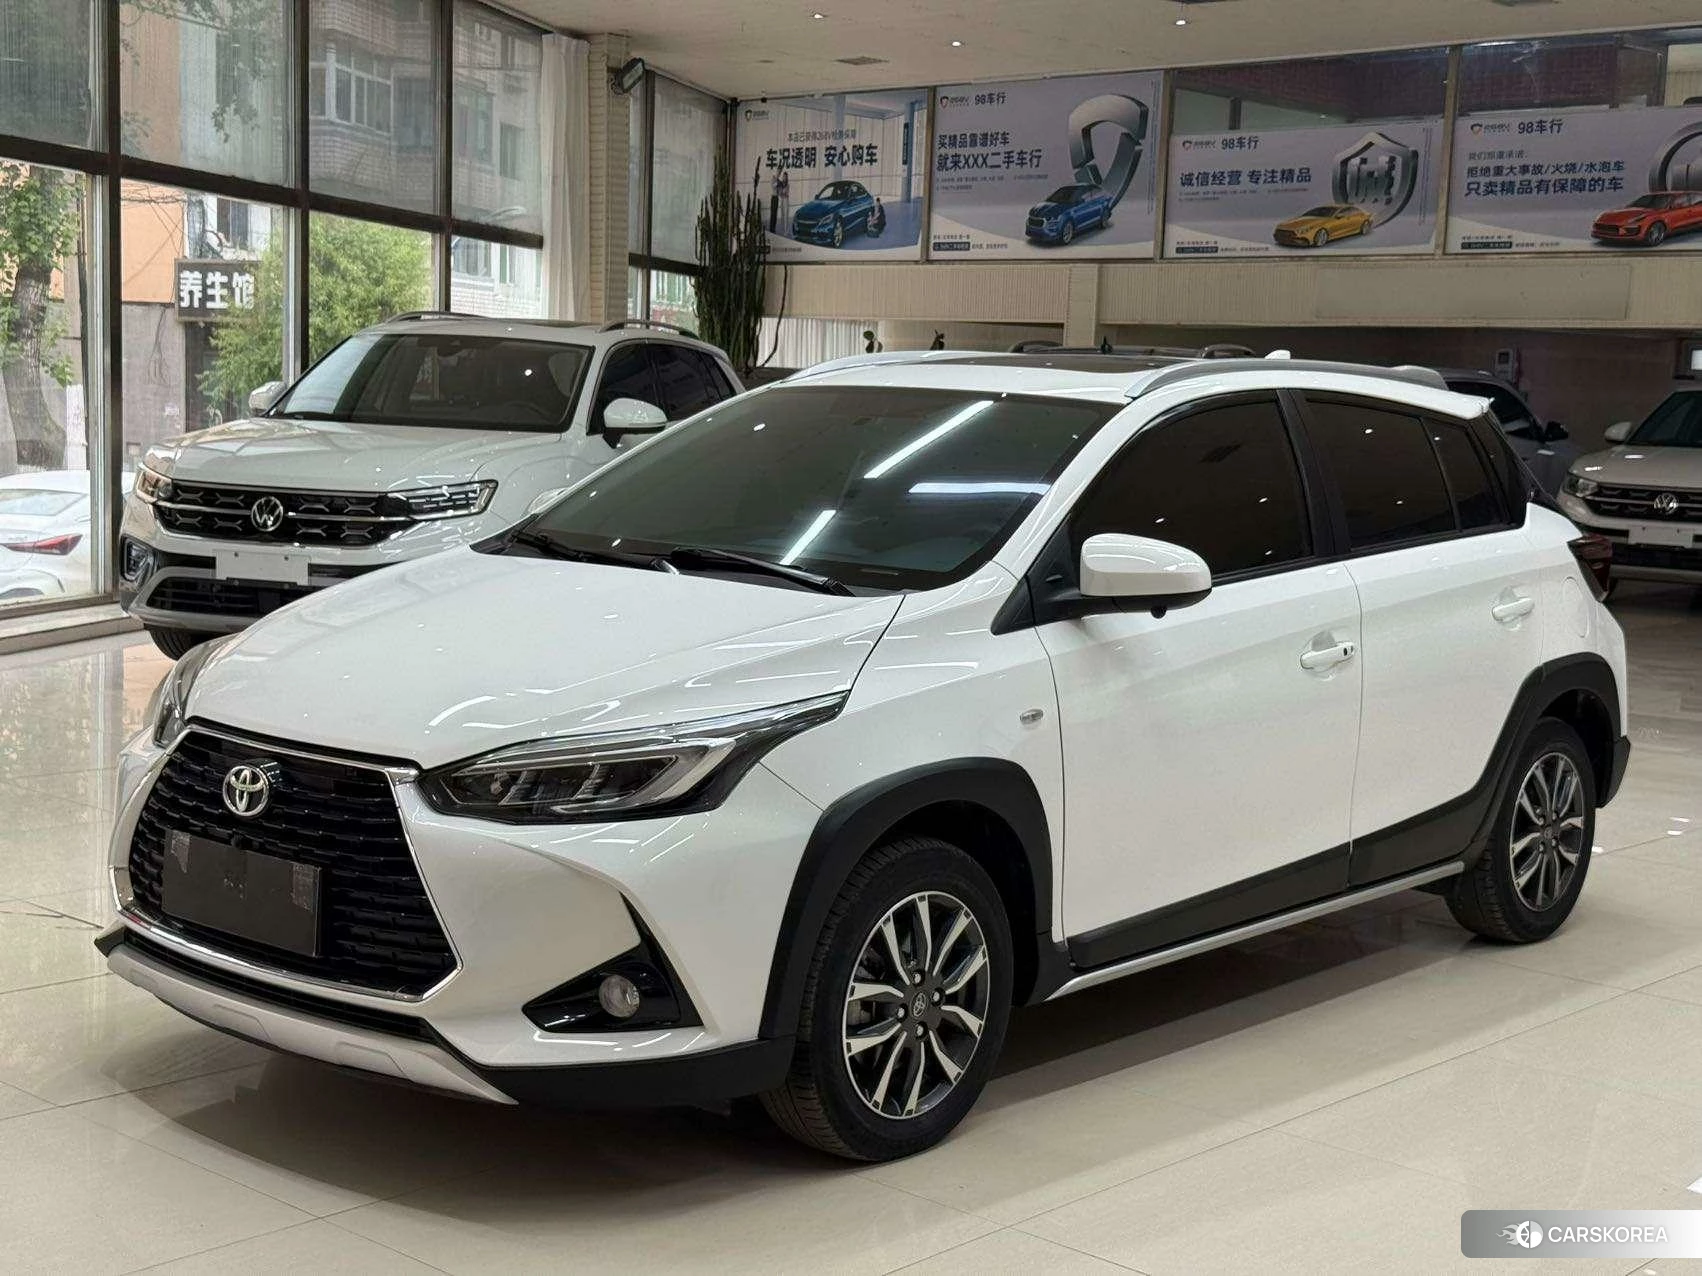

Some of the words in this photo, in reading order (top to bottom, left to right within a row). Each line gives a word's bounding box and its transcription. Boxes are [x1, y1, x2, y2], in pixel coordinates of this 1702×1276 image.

[975, 92, 1007, 106] 98车行
[1518, 119, 1563, 133] 98车行
[938, 132, 1010, 150] 买精品靠谱好车
[1221, 136, 1259, 150] 98车行
[765, 146, 817, 170] 车况透明
[823, 143, 878, 168] 安心购车
[937, 150, 1042, 171] 就来XXX二手车行
[1179, 170, 1241, 188] 诚信经营
[1247, 167, 1312, 185] 专注精品
[1464, 176, 1624, 197] 只卖精品有保障的车
[180, 270, 255, 309] 养生馆
